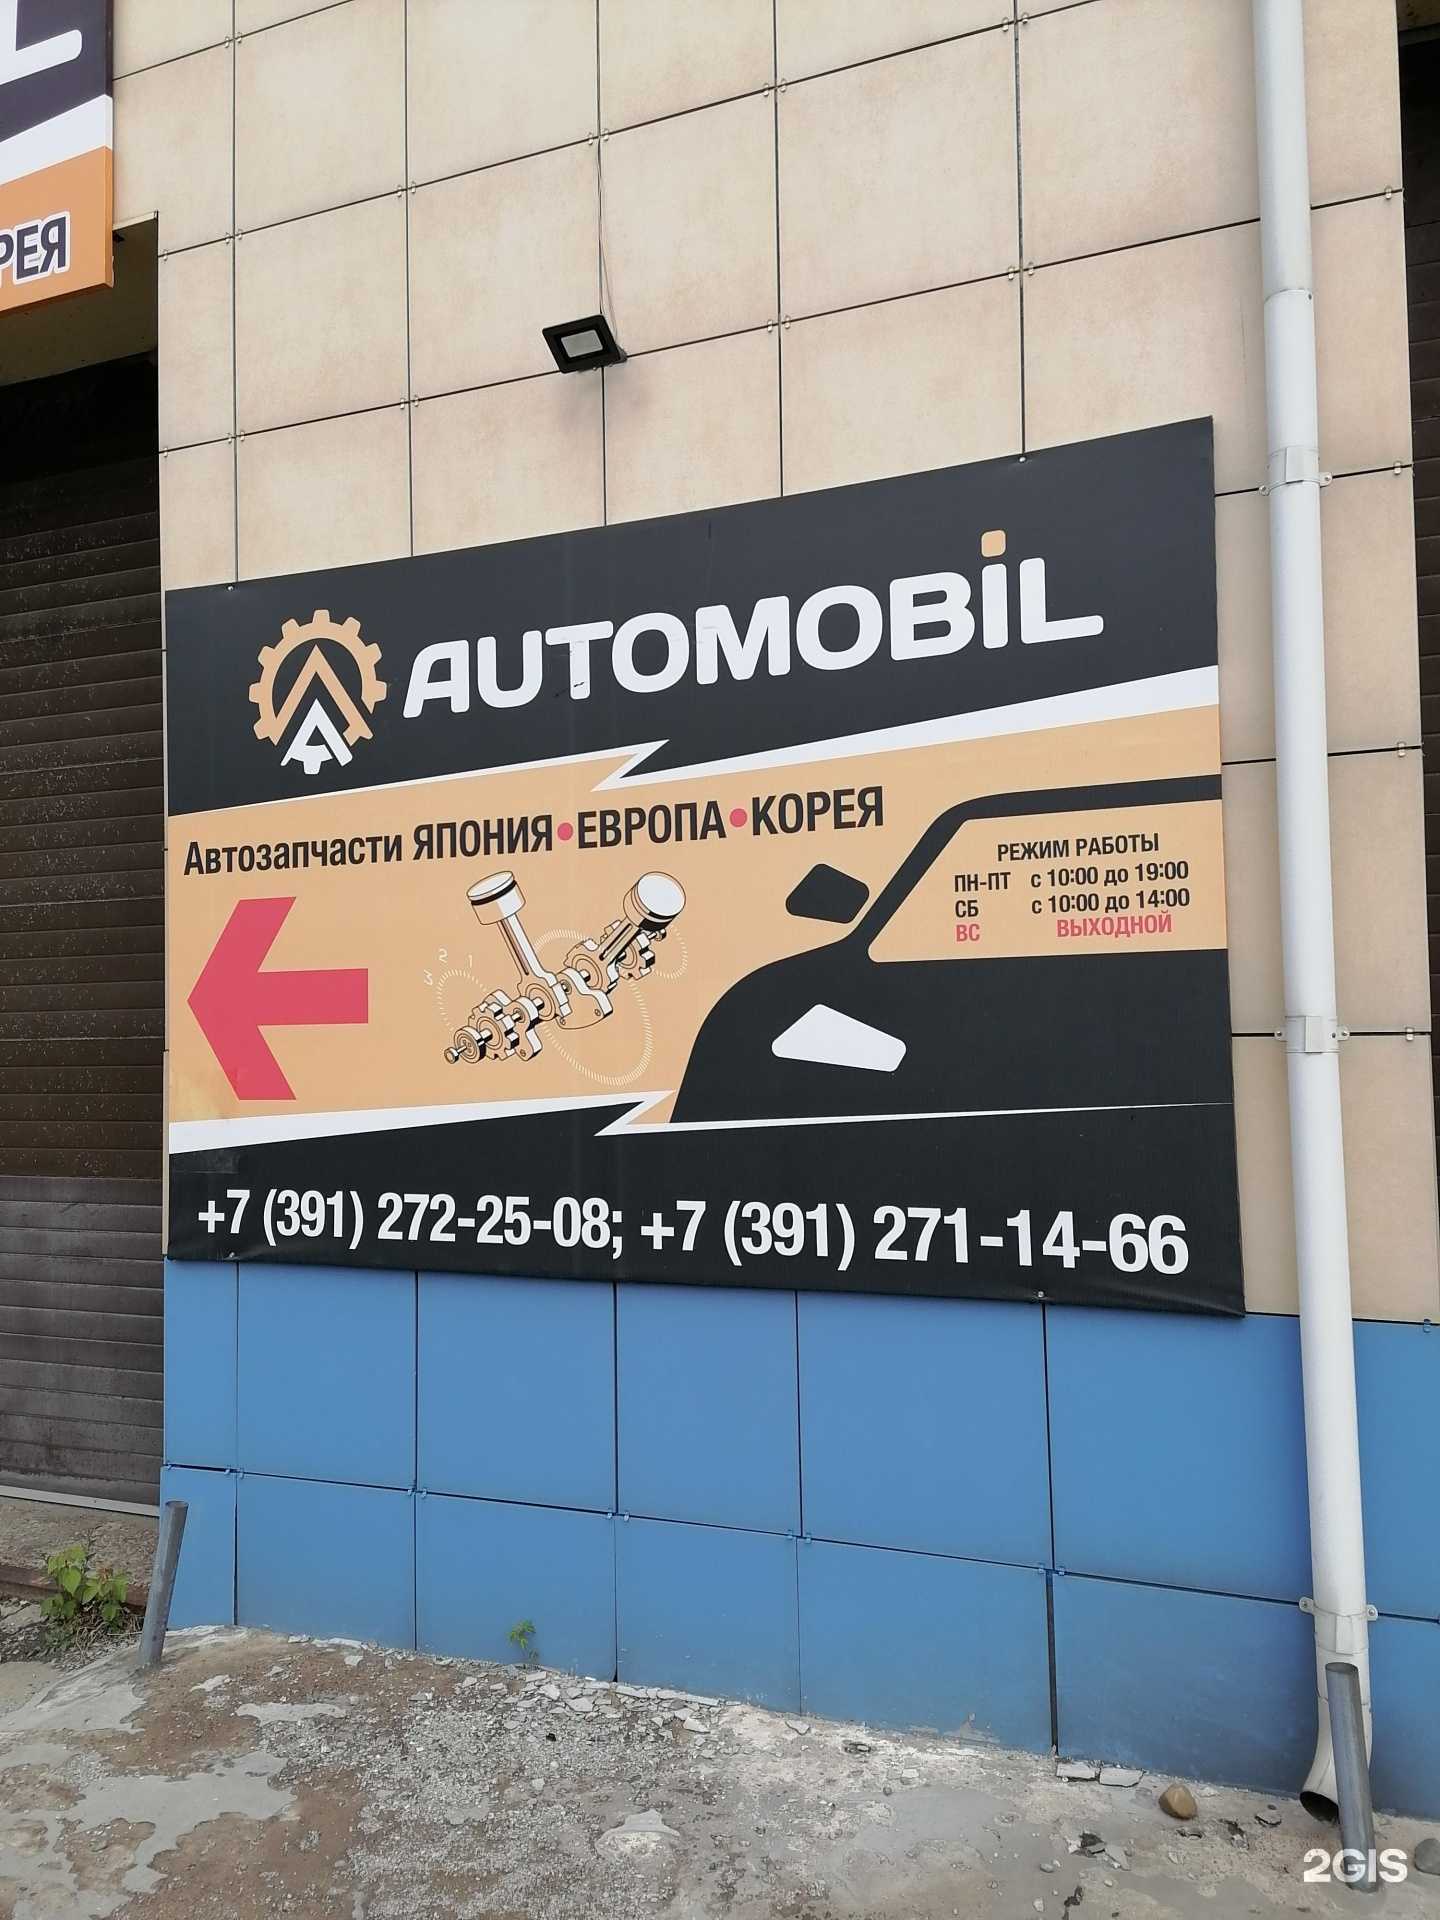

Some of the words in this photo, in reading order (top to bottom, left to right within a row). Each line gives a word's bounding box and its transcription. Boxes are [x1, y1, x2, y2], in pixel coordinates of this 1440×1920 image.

[183, 832, 402, 875] Автозапчасти
[751, 786, 884, 836] КОРЕЯ
[997, 840, 1069, 862] РЕЖИМ
[1076, 833, 1159, 856] РАБОТЫ
[954, 872, 1011, 893] ПН-ПТ
[1047, 867, 1099, 887] 10:00
[1104, 868, 1129, 886] до
[1135, 861, 1189, 882] 19:00
[955, 900, 979, 918] СБ
[1049, 893, 1100, 913] 10:00
[1105, 895, 1130, 913] до
[1136, 888, 1190, 909] 14:00
[956, 924, 980, 942] ВС
[1056, 911, 1172, 938] ВЫХОДНОЙ
[198, 1189, 250, 1234] +7
[263, 1188, 364, 1250] (391)
[377, 1192, 624, 1260] 272-25-08;
[640, 1200, 706, 1252] +7
[724, 1200, 855, 1271] (391)
[873, 1205, 1189, 1275] 271-14-66
